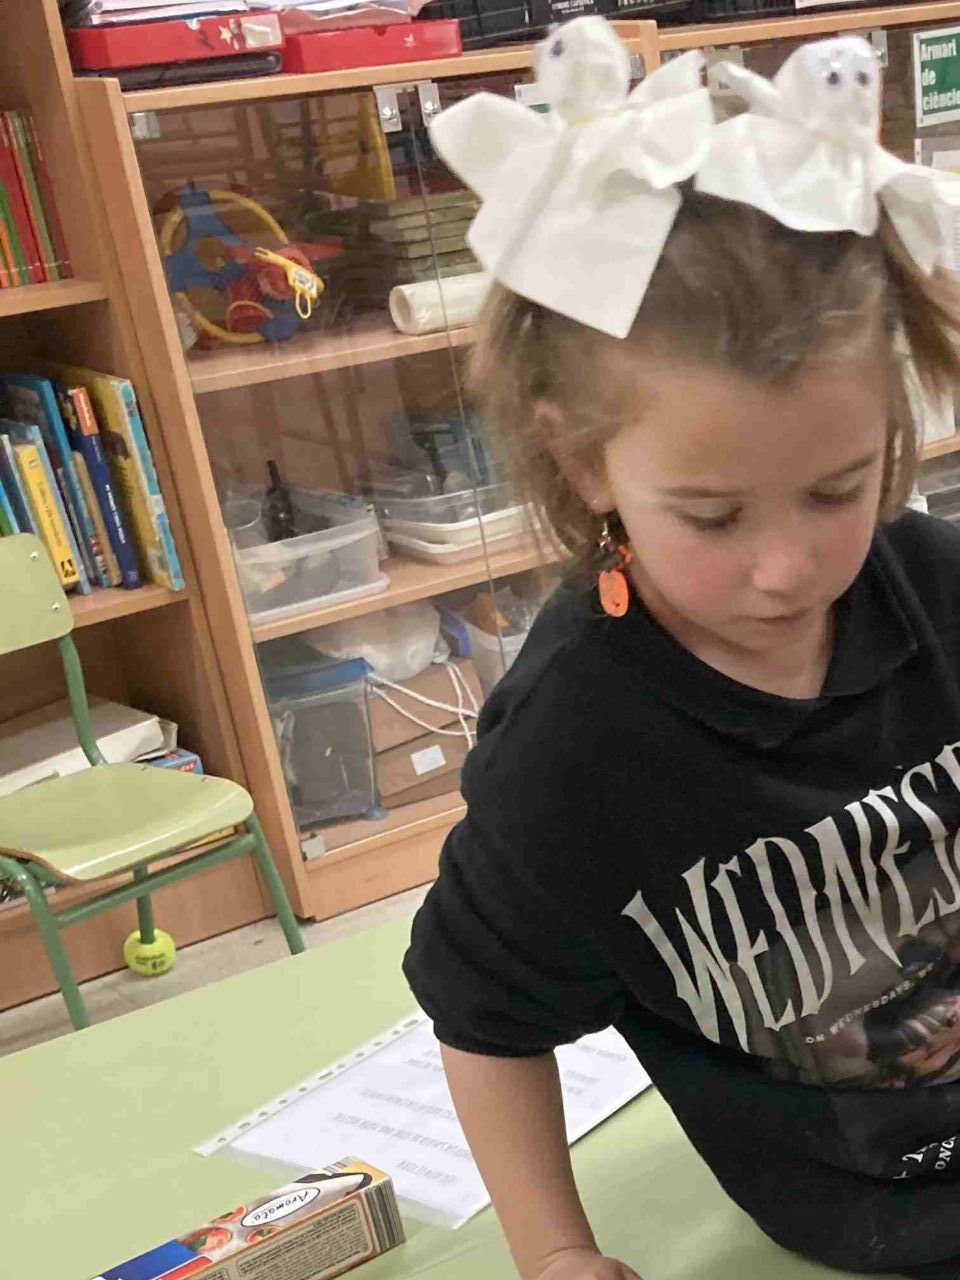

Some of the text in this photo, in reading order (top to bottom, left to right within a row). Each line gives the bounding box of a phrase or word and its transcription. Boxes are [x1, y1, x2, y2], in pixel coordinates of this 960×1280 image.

[920, 38, 957, 62] Armari
[922, 68, 937, 86] de
[254, 1190, 309, 1221] Aromata
